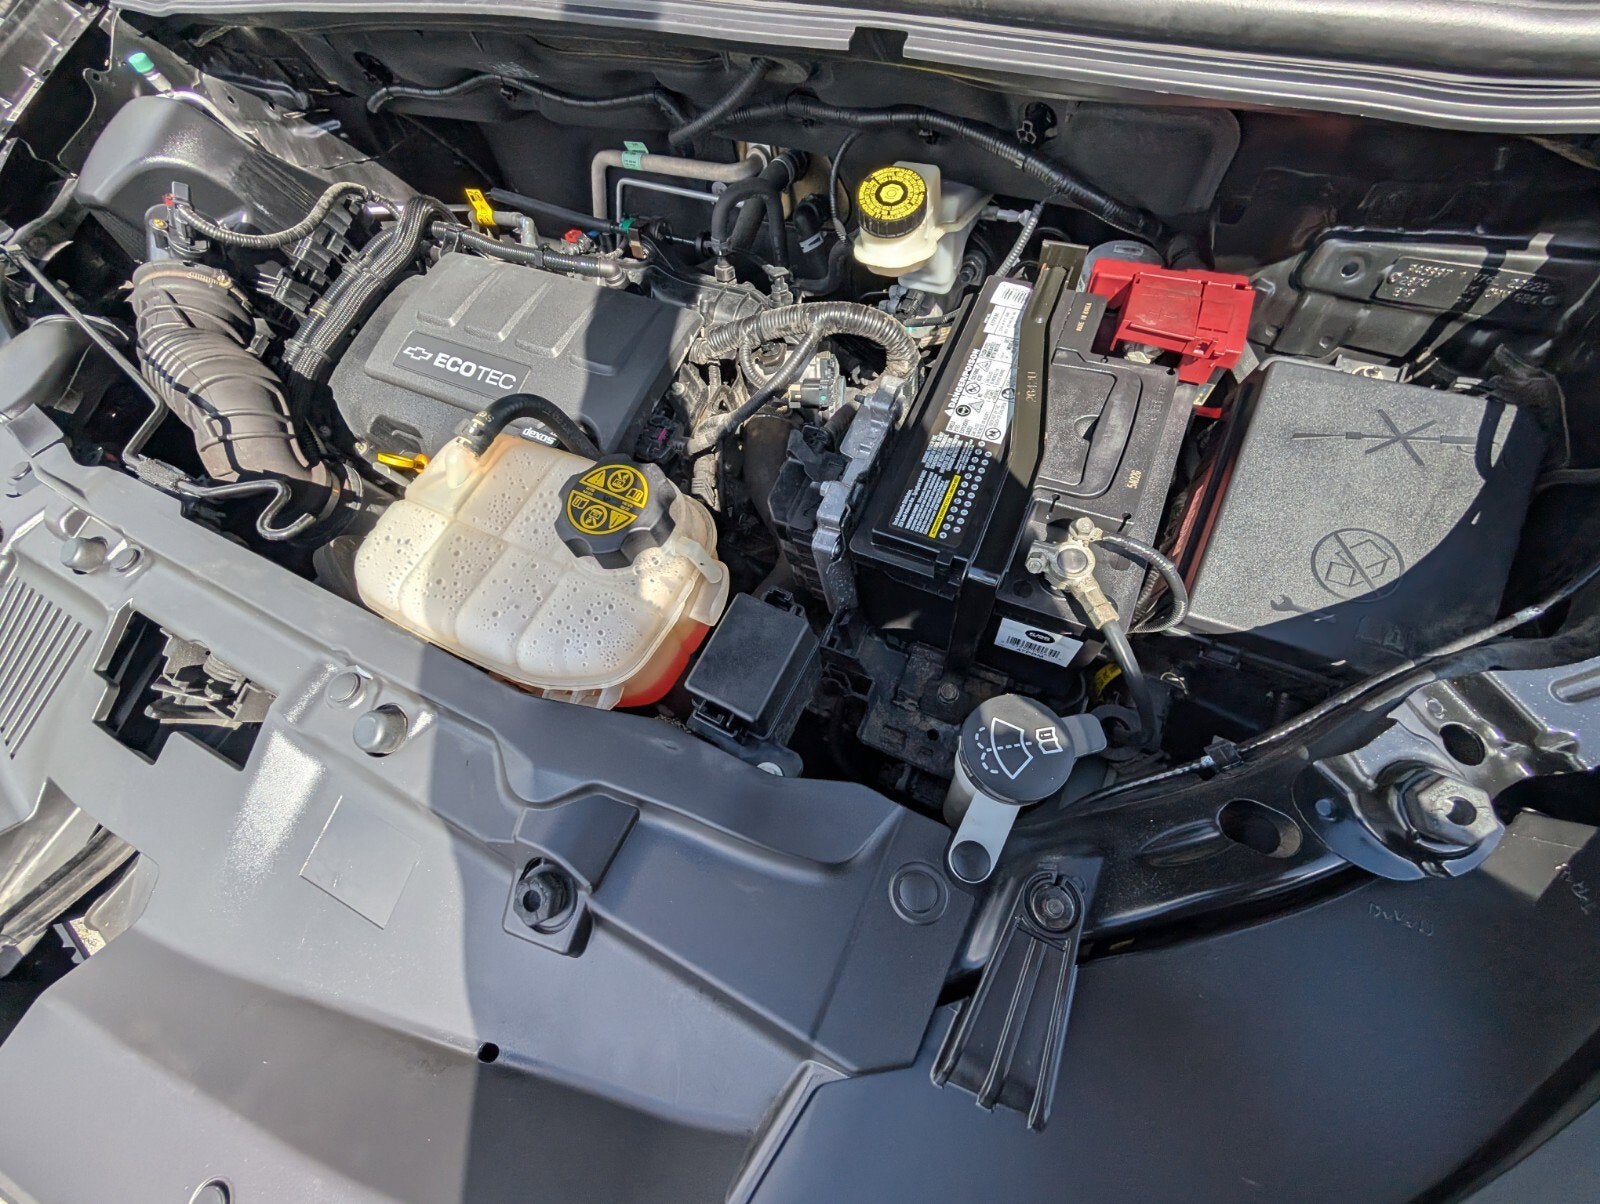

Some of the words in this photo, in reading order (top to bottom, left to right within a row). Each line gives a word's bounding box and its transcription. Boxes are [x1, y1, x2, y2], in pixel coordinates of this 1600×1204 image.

[432, 351, 517, 391] ECOTEC
[947, 348, 980, 411] DANGER/POISON
[521, 427, 556, 445] dexos
